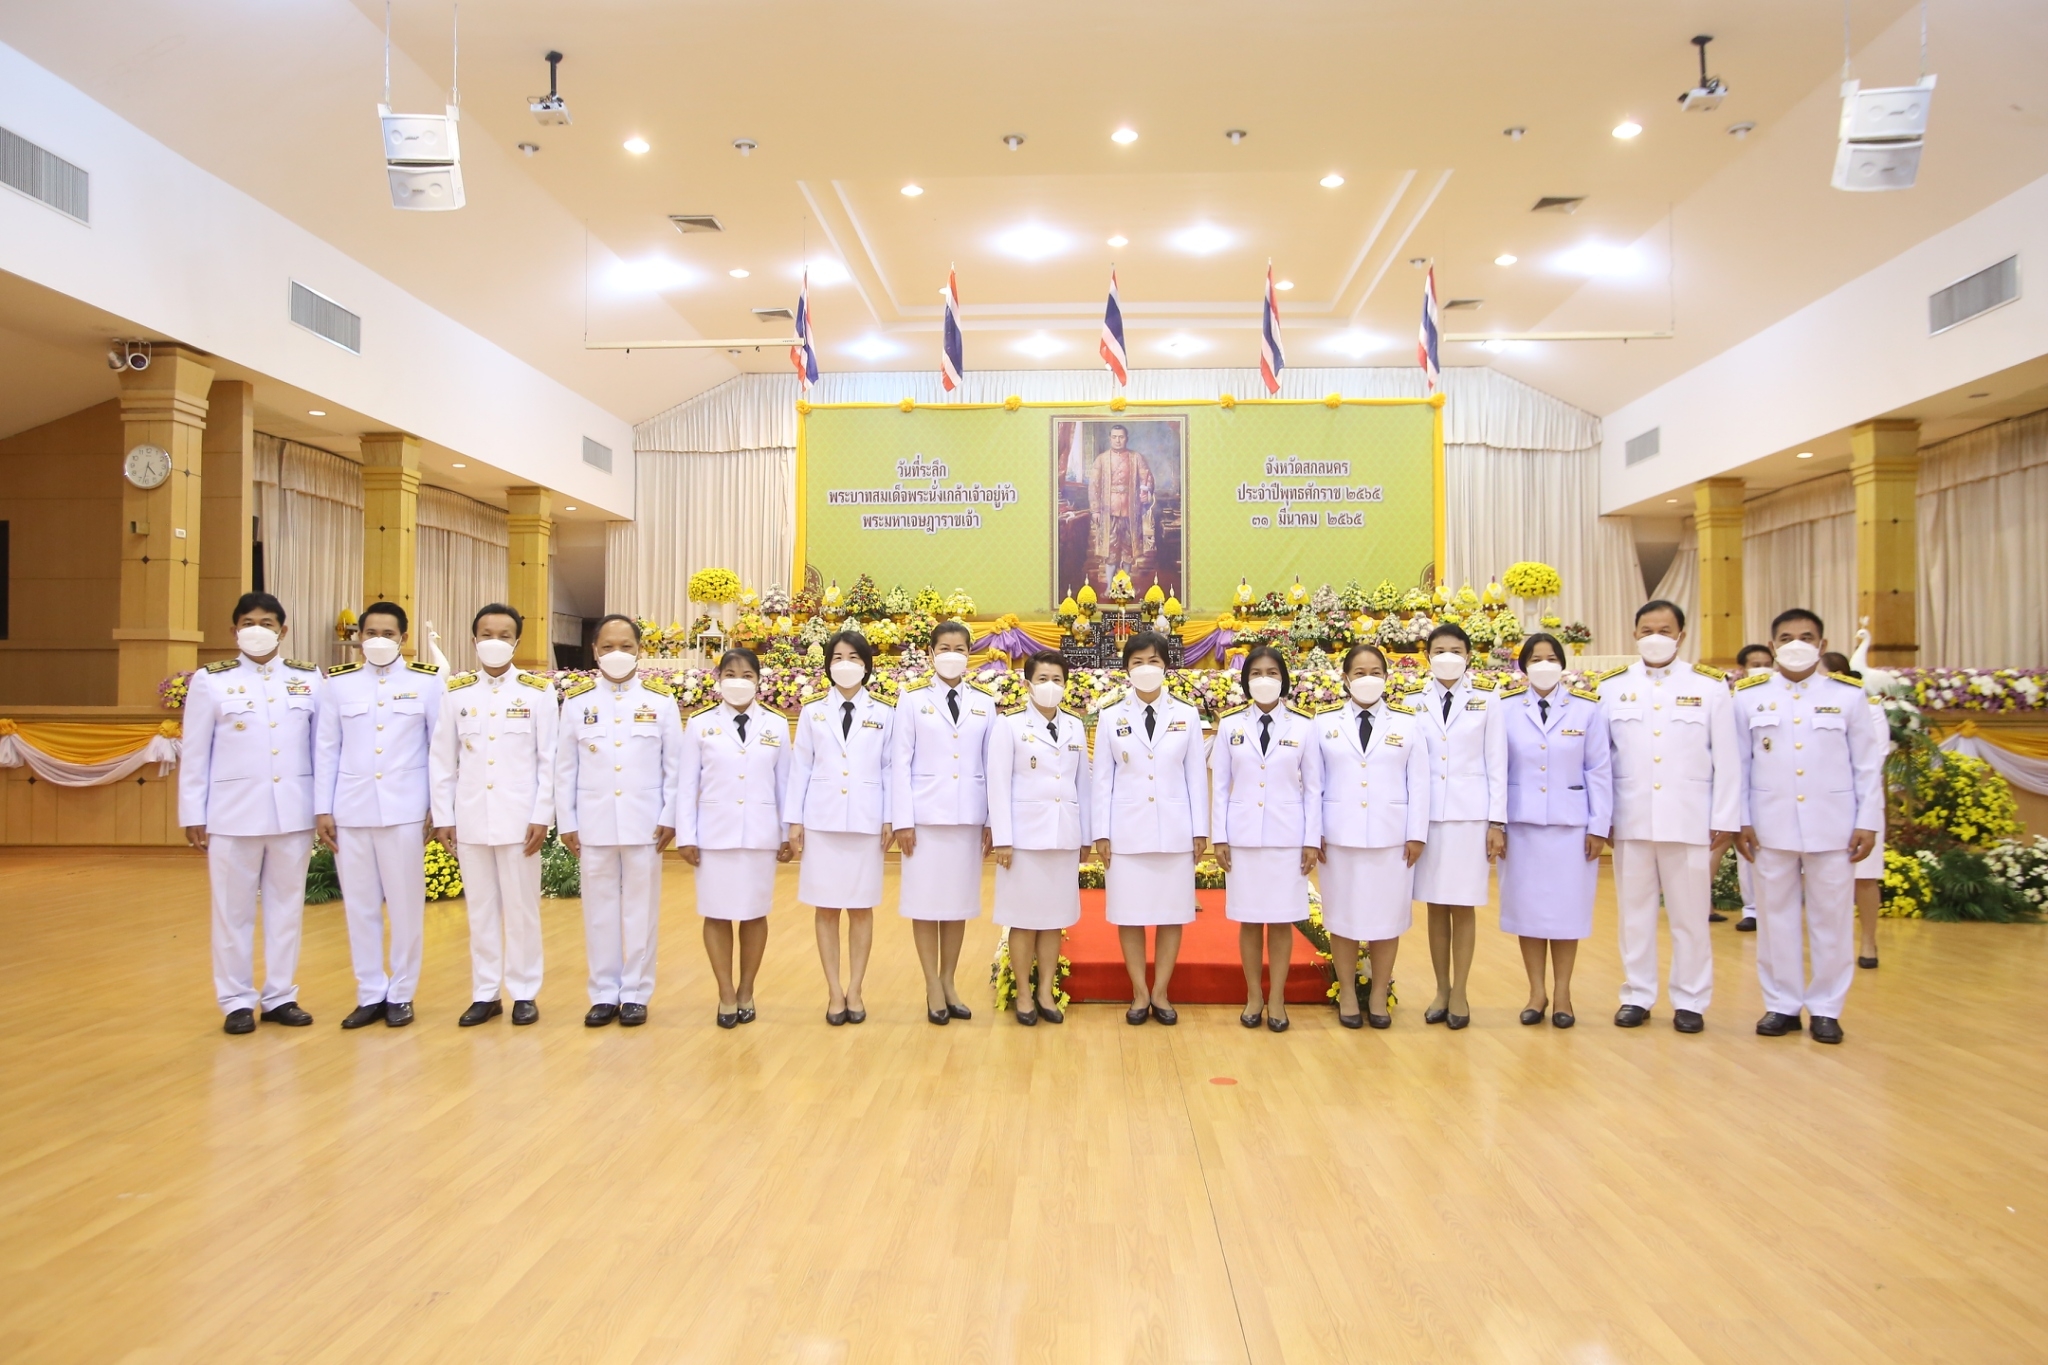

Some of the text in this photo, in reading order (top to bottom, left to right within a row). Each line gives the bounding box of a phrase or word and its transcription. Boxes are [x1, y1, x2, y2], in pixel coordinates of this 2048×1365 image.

[896, 454, 947, 478] วันที่ระลึก
[1265, 457, 1348, 475] จังหวัดสกลนคร
[829, 480, 1016, 508] พระบาทสมเด็จพระนั่งเกล้าเจ้าอยู่หัว
[1237, 482, 1382, 506] ประจำปีพุทธศักราช ๒๕๖๕
[863, 509, 979, 533] พระมหาเจษฎาราชเจ้า
[1251, 507, 1363, 526] ๓๑ มีนาคม ๒๕๖๕
